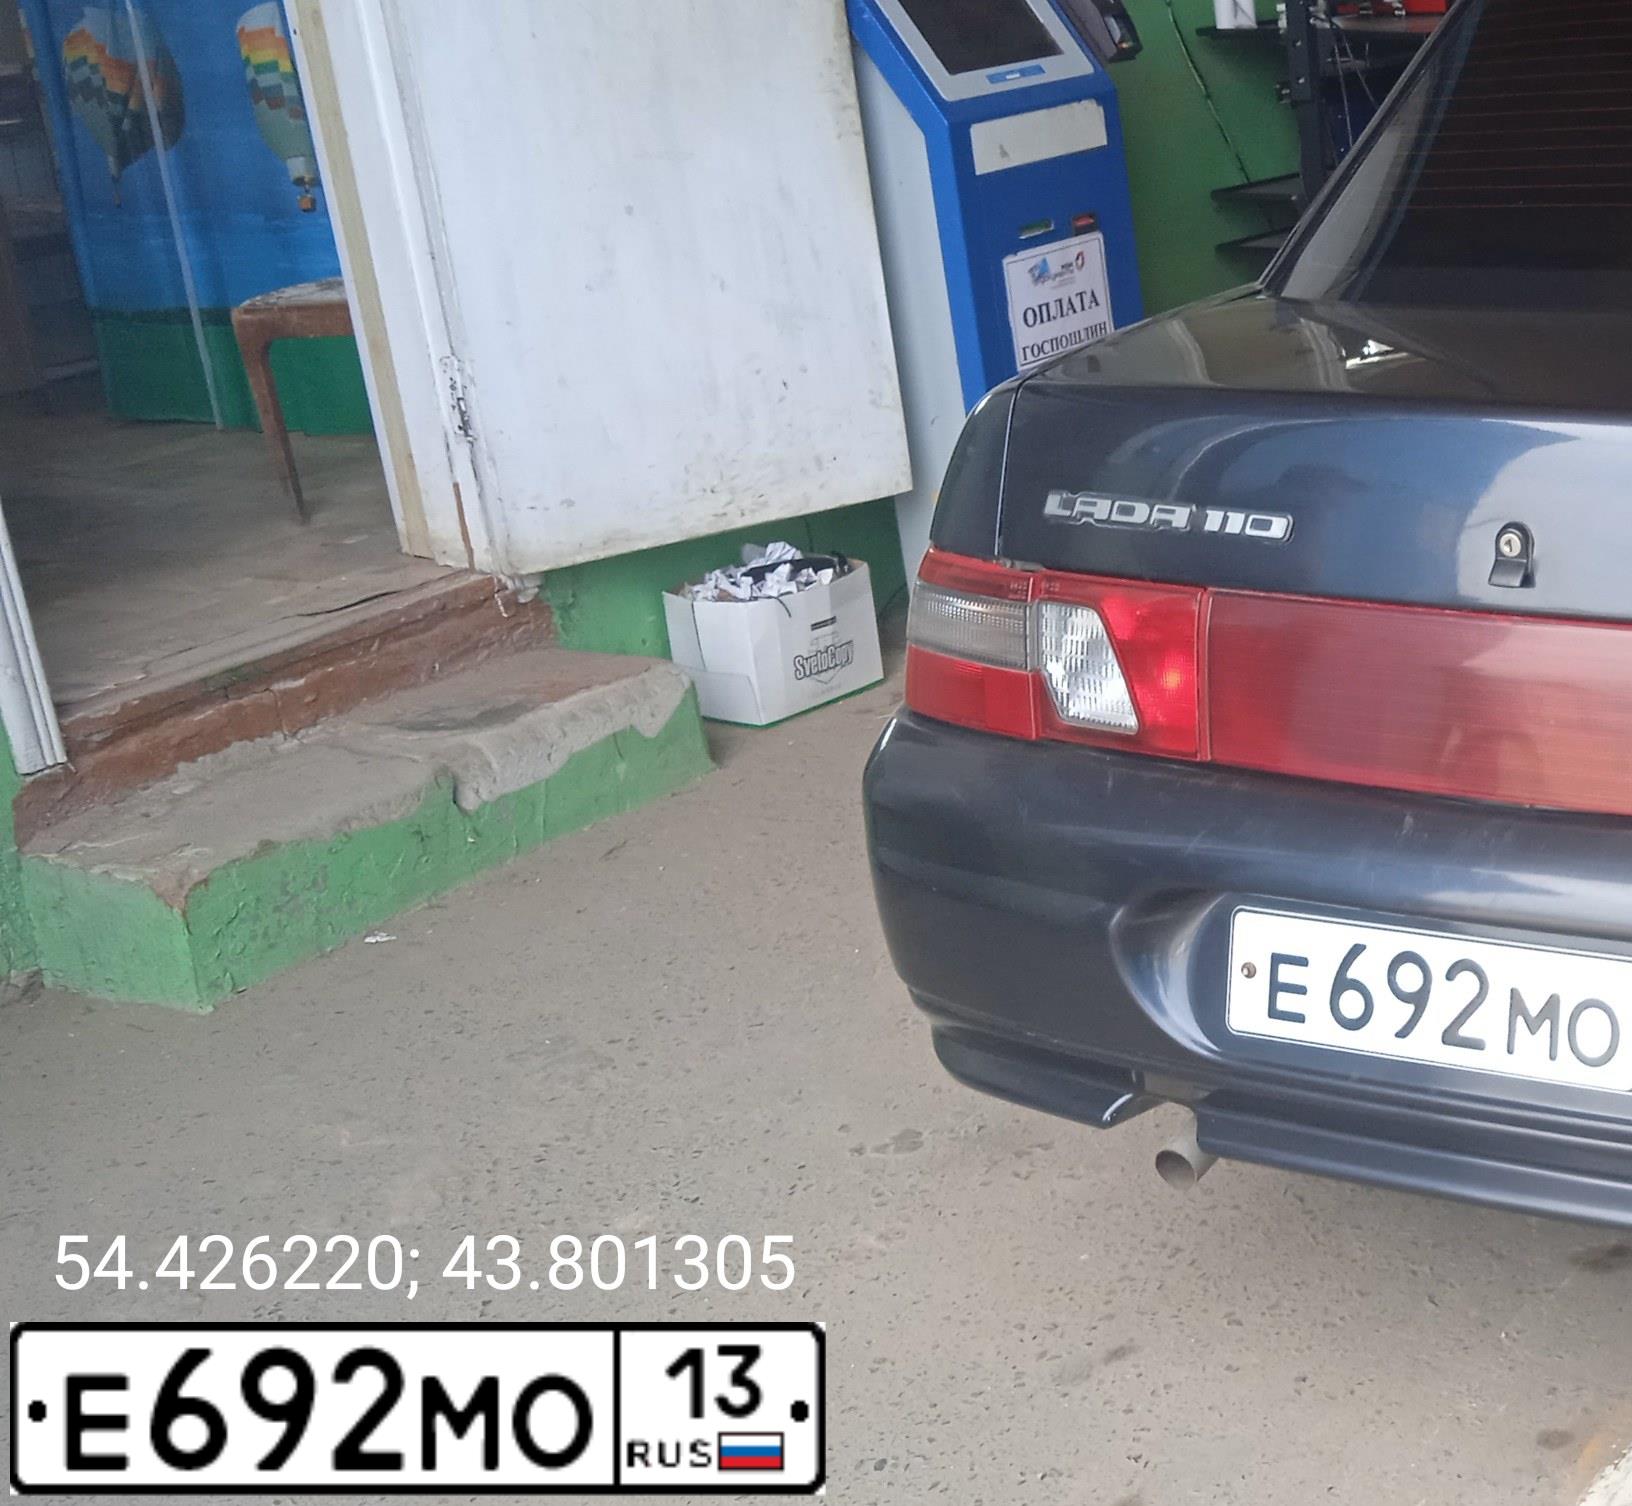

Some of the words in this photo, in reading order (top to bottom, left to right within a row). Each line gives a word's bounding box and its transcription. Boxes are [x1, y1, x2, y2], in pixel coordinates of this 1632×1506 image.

[1022, 289, 1100, 328] ОПЛАТА
[1021, 321, 1108, 361] ГОСПОШЛИН
[1043, 492, 1192, 530] LADA
[1203, 508, 1292, 541] 110
[793, 640, 854, 681] SvetoCopy
